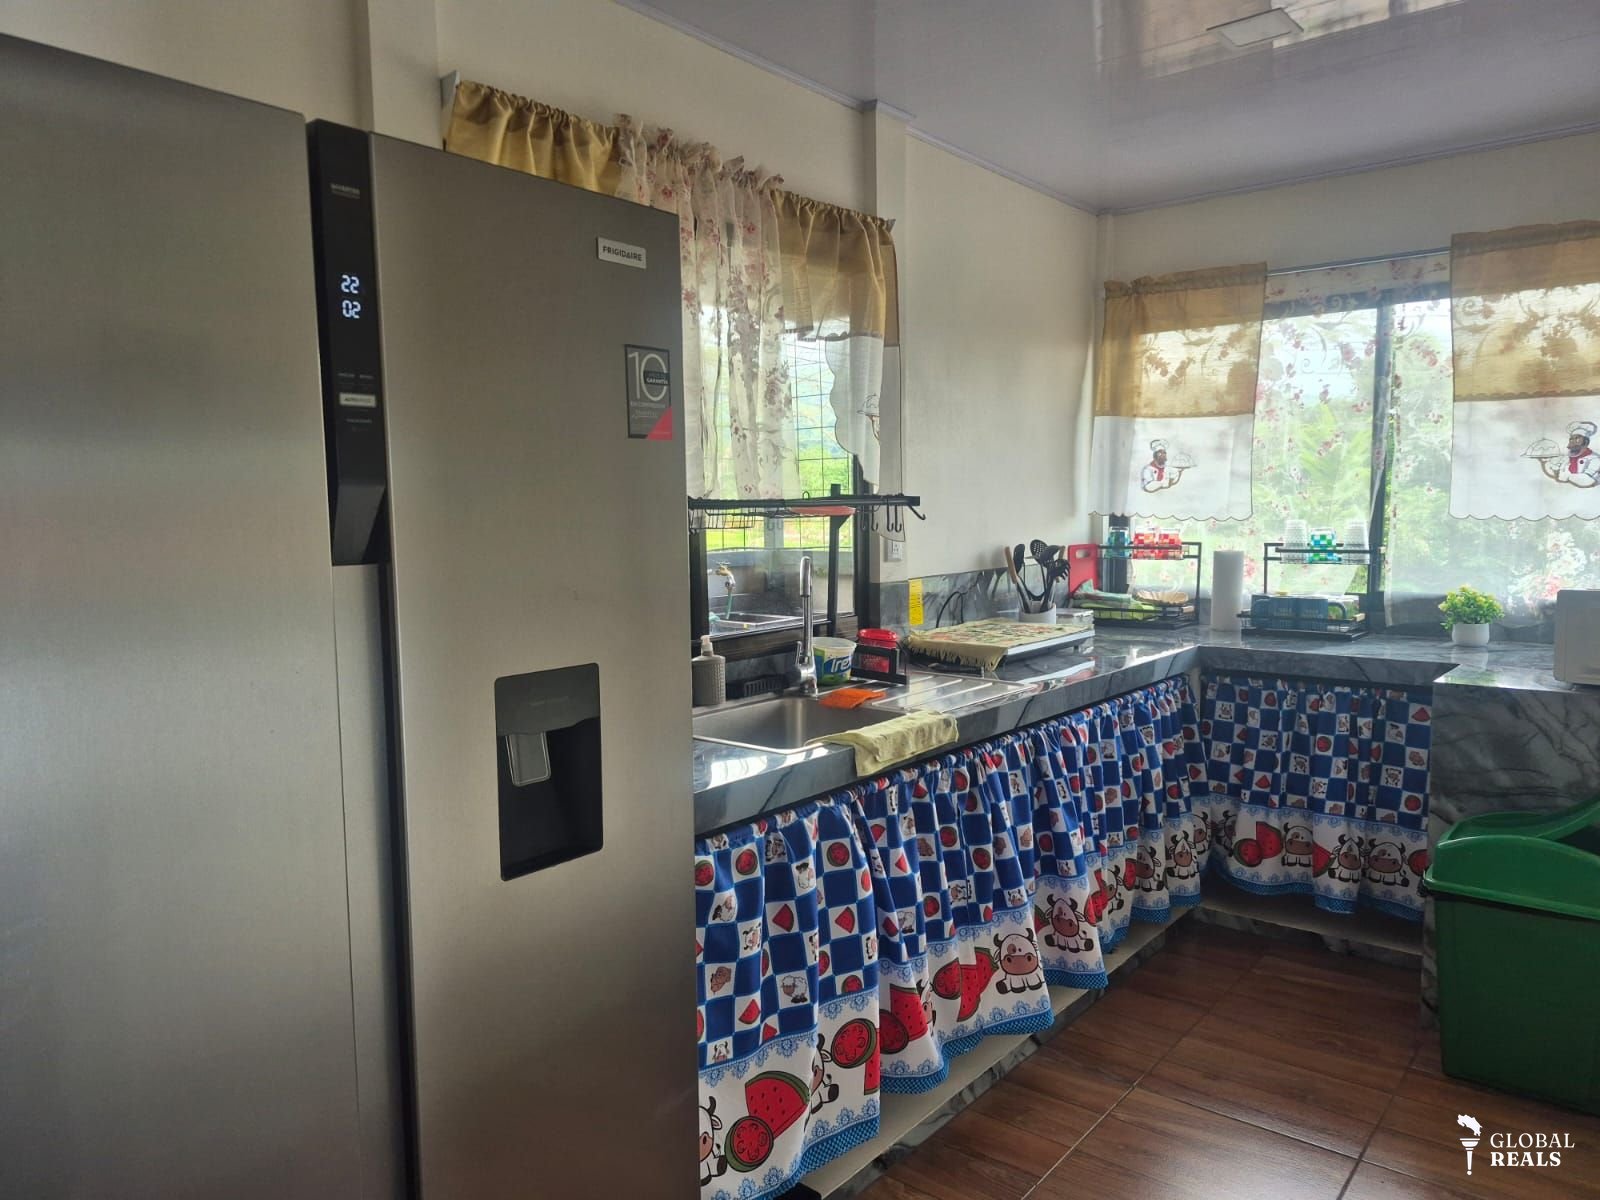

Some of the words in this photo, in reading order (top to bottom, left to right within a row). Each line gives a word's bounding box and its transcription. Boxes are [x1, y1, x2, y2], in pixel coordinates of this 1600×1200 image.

[602, 245, 643, 262] FRIGIDAIRE
[340, 274, 360, 294] 22
[341, 299, 362, 319] 02
[628, 351, 668, 402] 10
